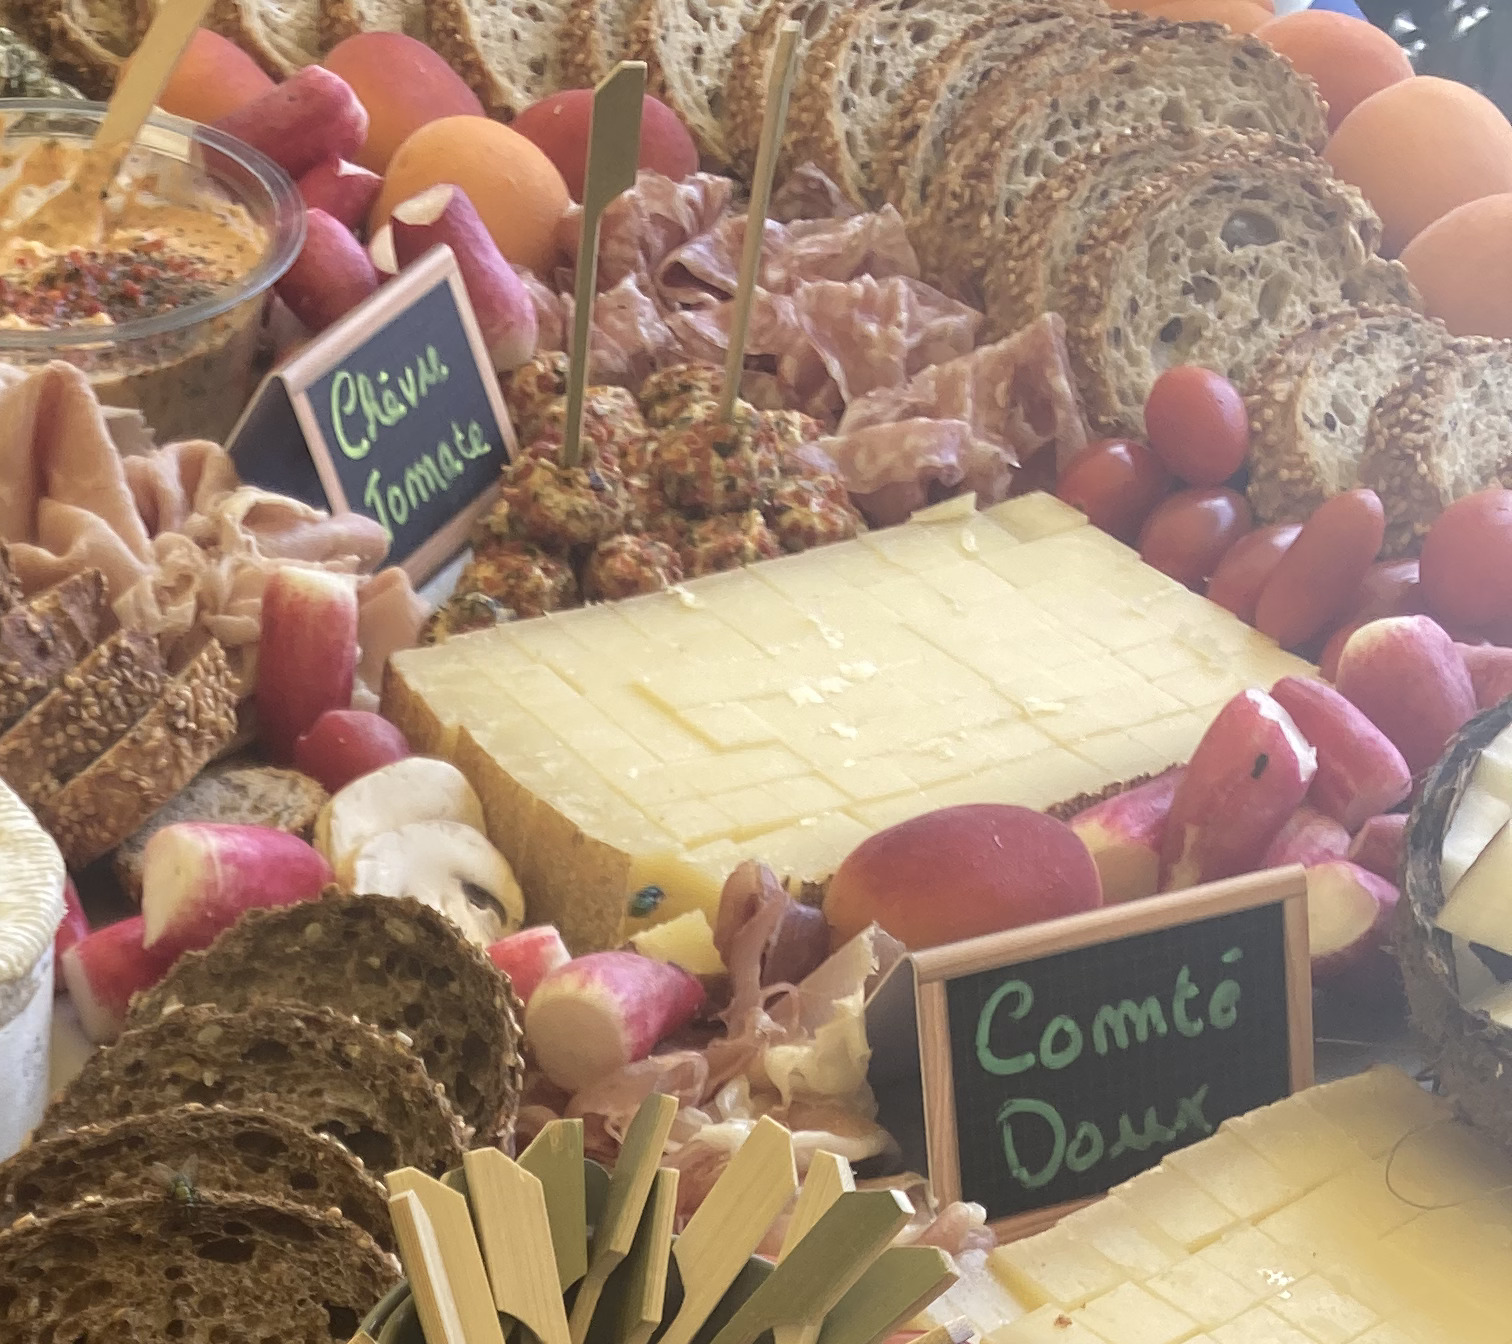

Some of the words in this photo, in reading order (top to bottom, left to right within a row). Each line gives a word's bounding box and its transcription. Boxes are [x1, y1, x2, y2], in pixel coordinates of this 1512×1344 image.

[363, 419, 492, 543] Tomate
[974, 946, 1245, 1076] Comté
[996, 1084, 1214, 1188] Doux
